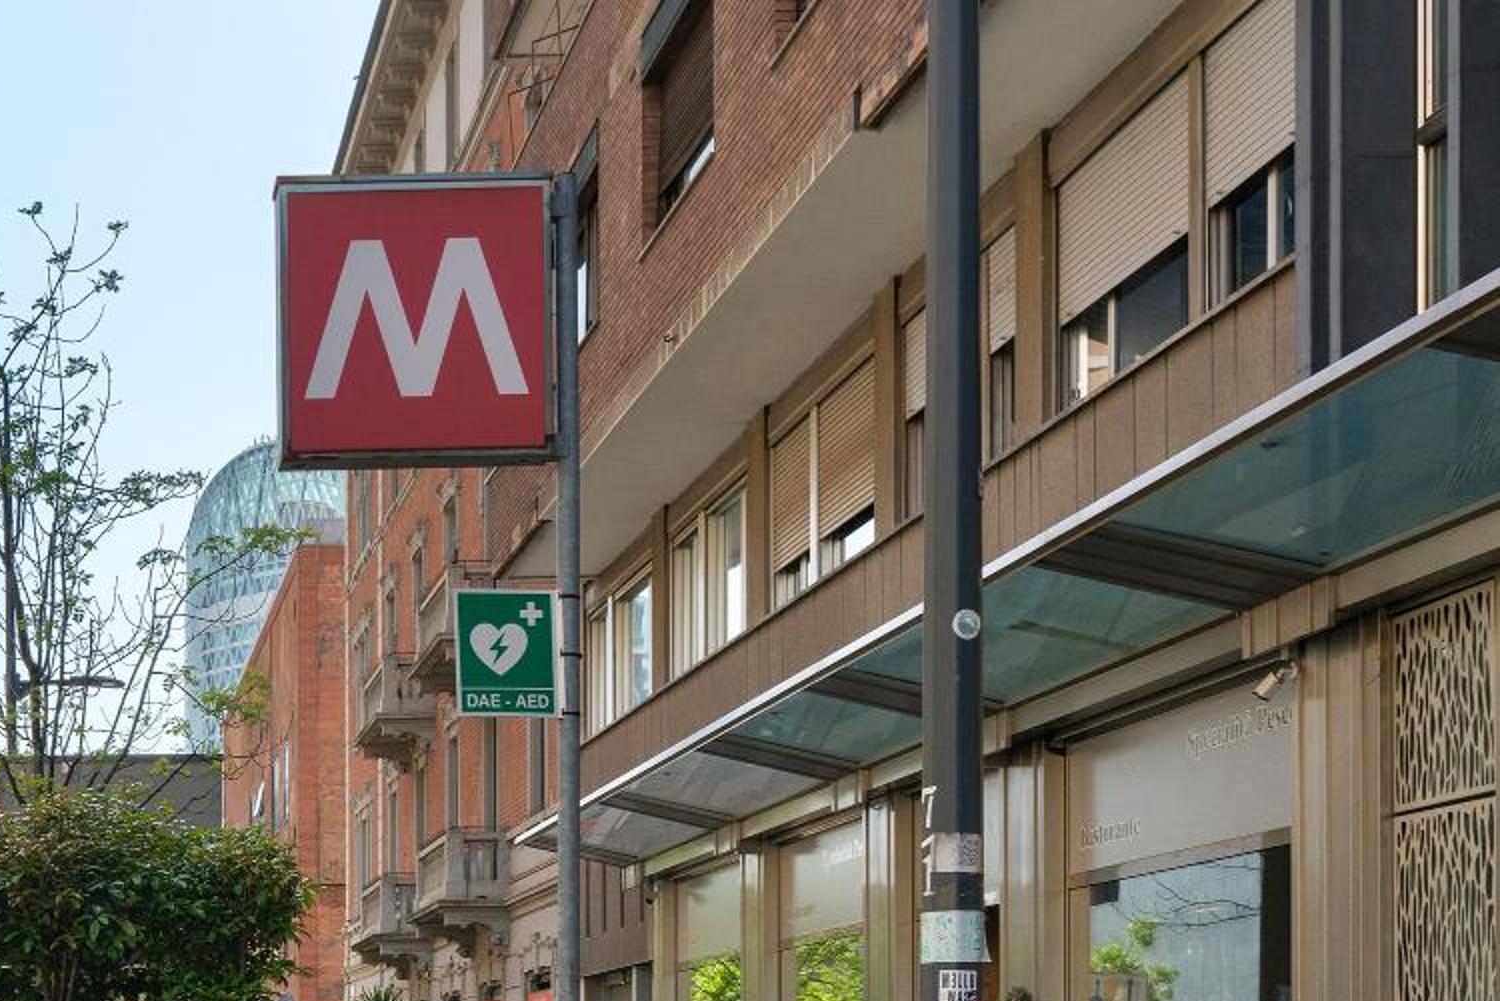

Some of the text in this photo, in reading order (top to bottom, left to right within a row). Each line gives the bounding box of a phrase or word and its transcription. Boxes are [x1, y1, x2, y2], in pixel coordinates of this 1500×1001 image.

[304, 236, 530, 399] M
[466, 693, 501, 709] DAE
[515, 693, 549, 709] AED
